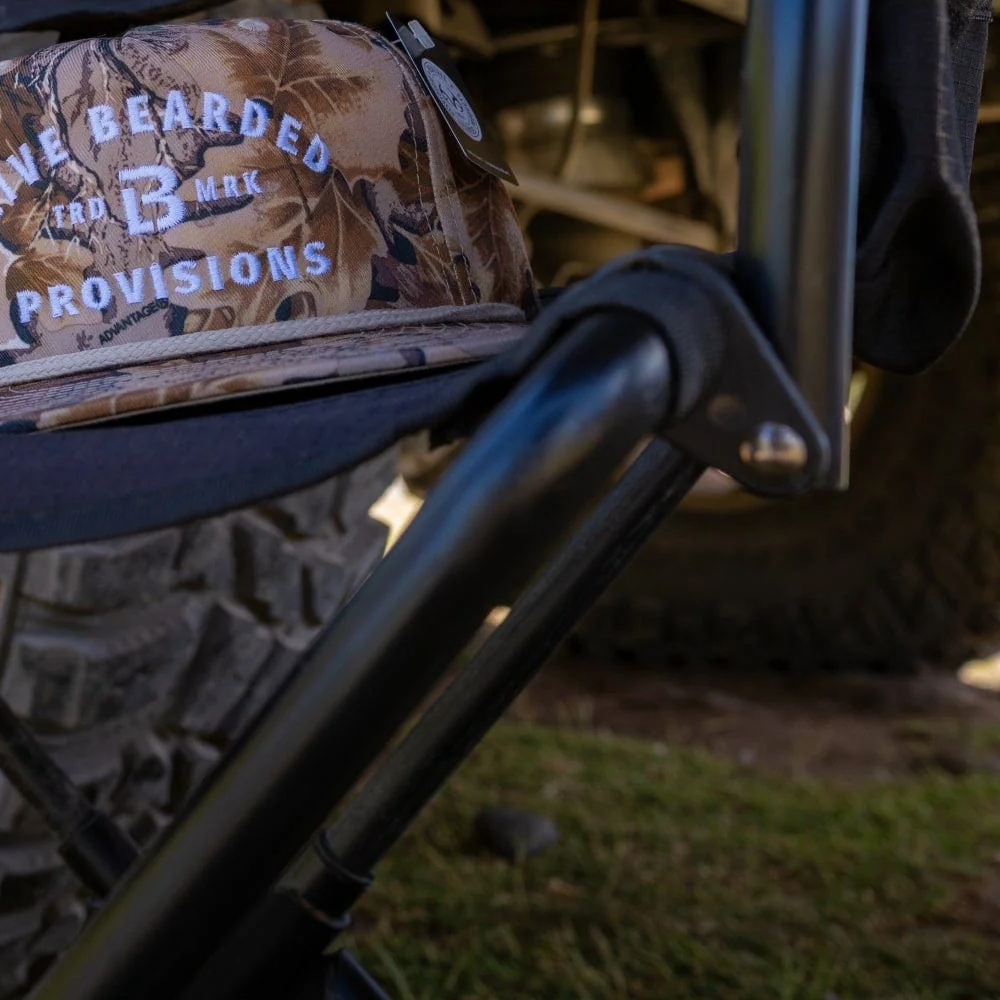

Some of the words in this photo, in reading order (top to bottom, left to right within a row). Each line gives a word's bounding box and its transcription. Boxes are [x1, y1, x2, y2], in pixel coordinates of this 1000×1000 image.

[88, 89, 331, 173] BEARDED
[52, 197, 106, 229] TRD
[118, 163, 187, 236] B
[195, 169, 263, 203] MRK
[15, 240, 332, 324] PROVISIONS
